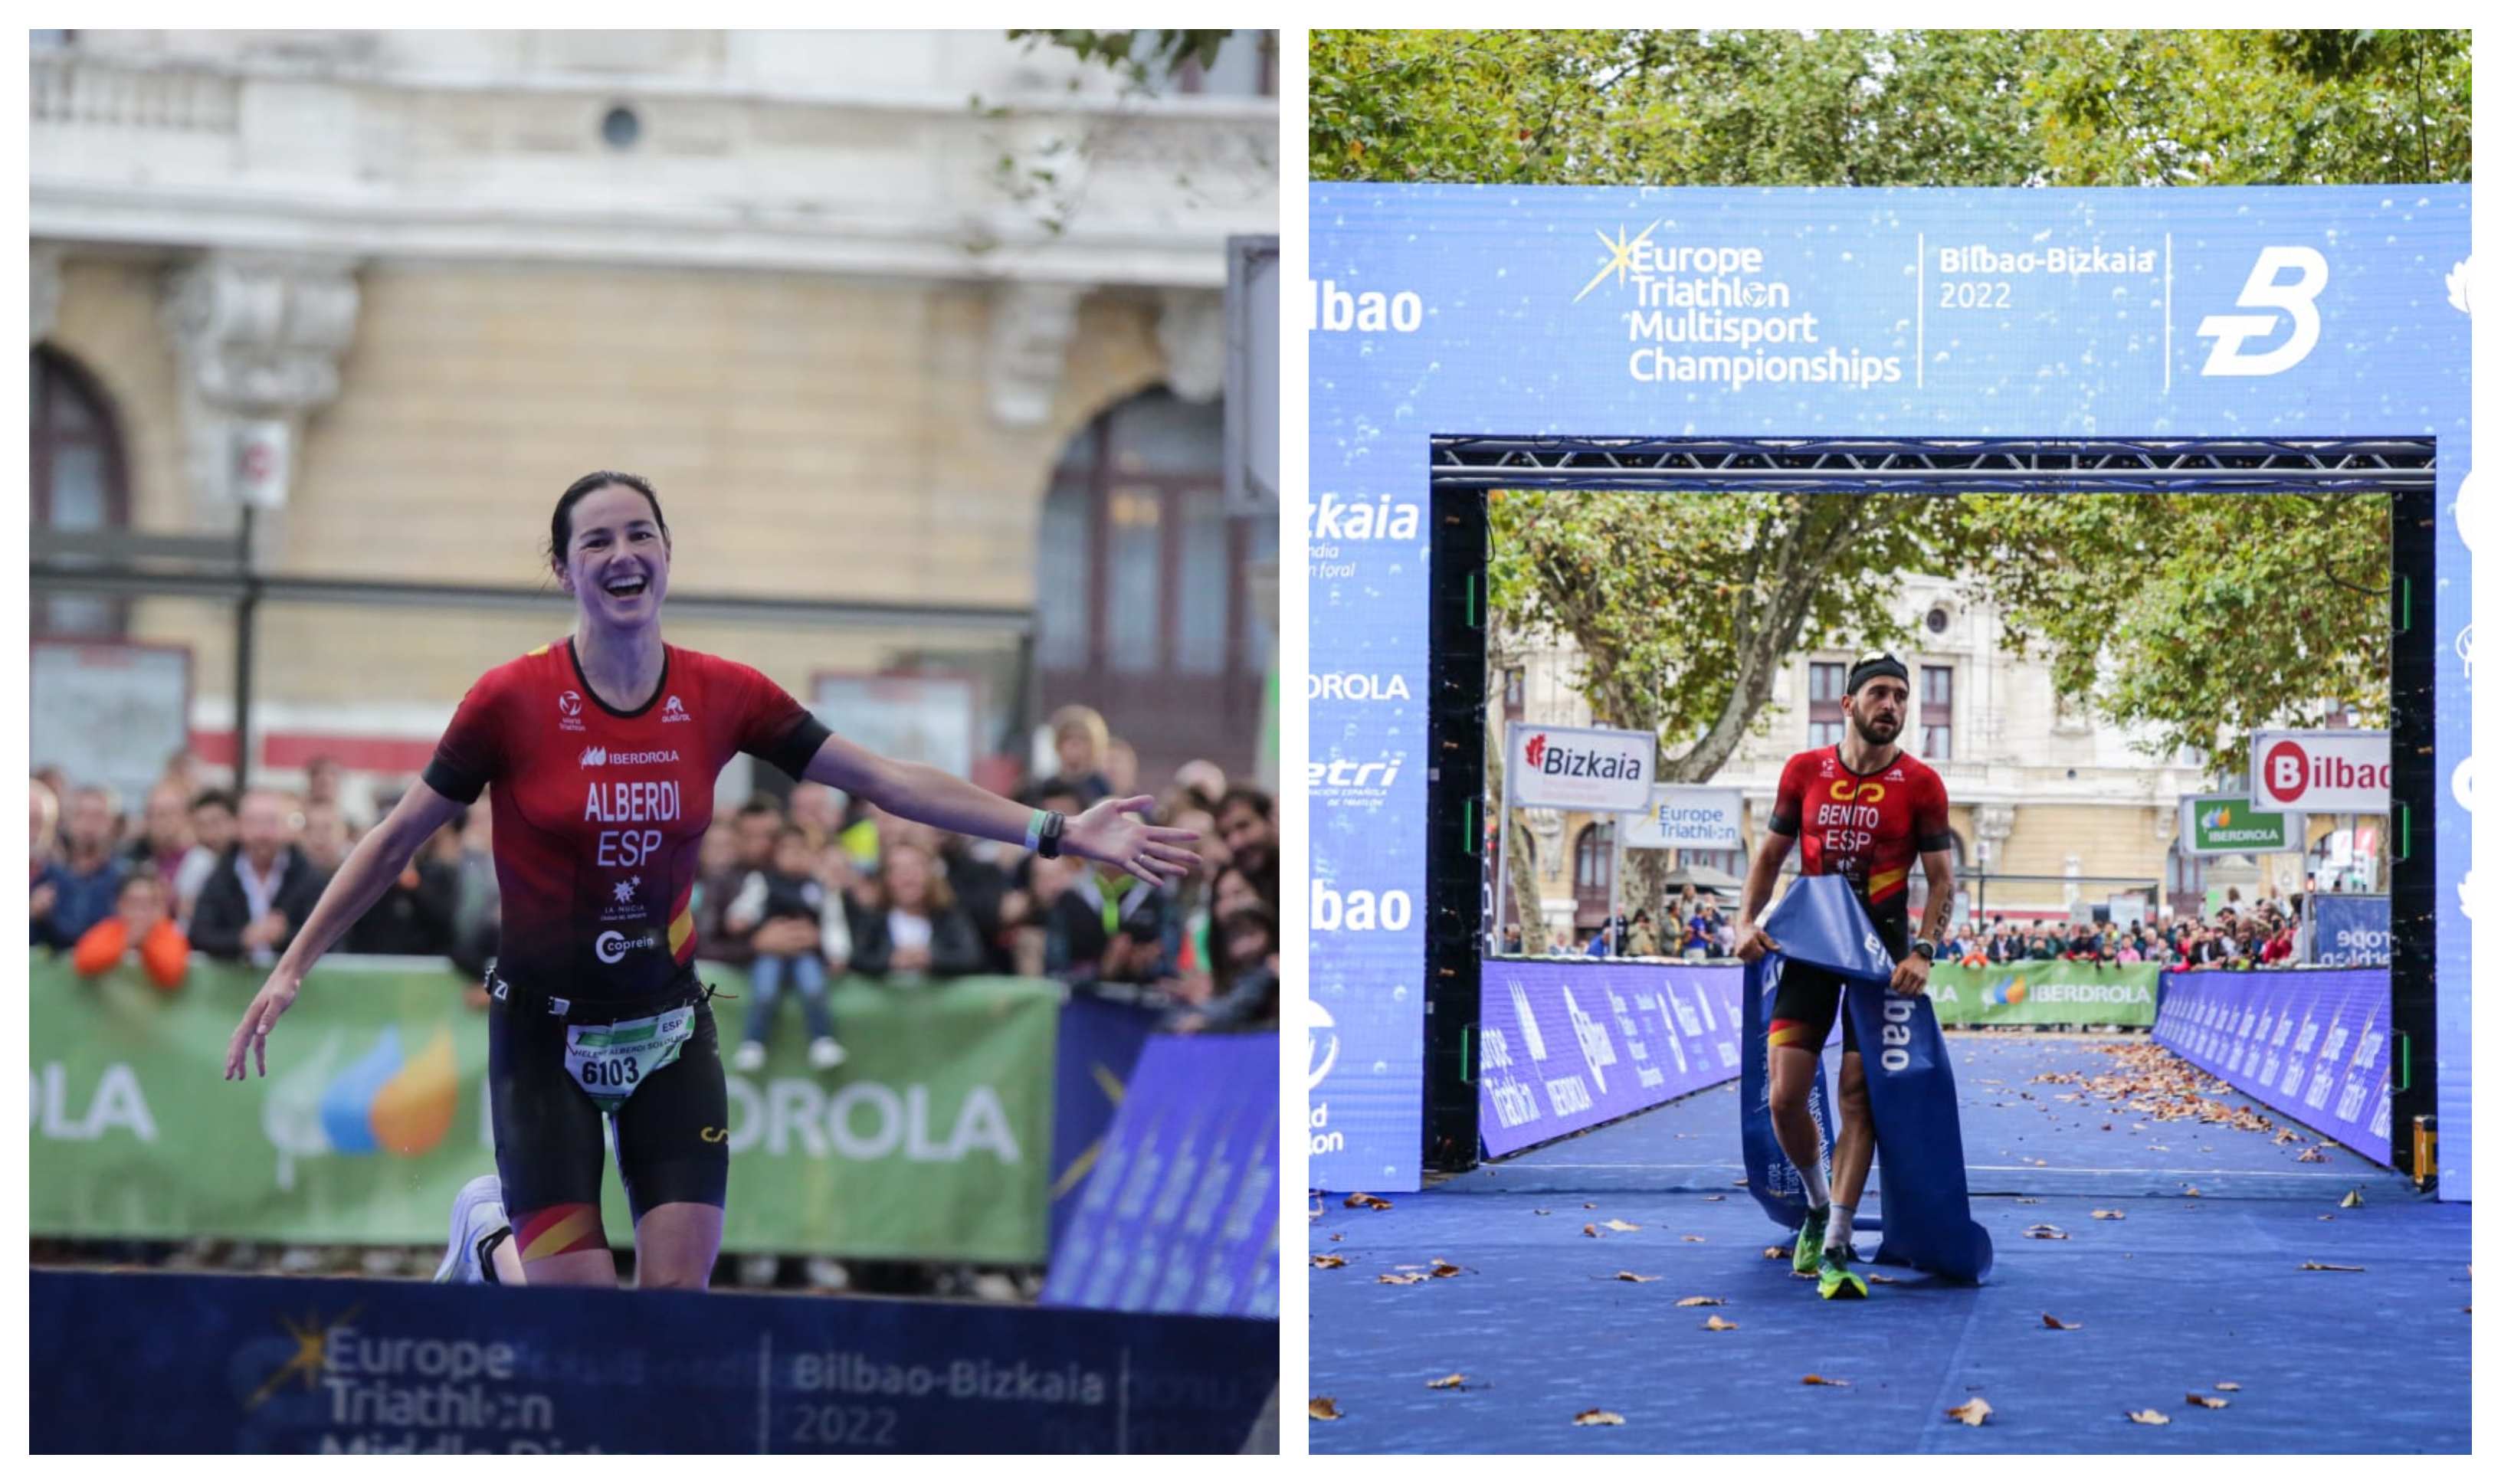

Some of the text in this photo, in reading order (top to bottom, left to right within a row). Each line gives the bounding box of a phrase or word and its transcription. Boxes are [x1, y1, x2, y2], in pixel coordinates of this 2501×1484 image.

[1631, 240, 1763, 277] Europe
[1939, 245, 2154, 274] Bilbao-Bizkaia
[1630, 275, 1790, 308] Triathlon
[1939, 283, 2012, 309] 2022
[1629, 308, 1819, 349] Multisport
[1629, 346, 1902, 391] Championships
[609, 750, 680, 765] IBERDROLA
[1544, 747, 1641, 781] Bizkaia
[585, 780, 680, 822] ALBERDI
[1660, 804, 1724, 823] Europe
[1818, 804, 1879, 829] BENITO
[598, 830, 663, 866] ESP
[1825, 829, 1872, 852] ESP
[2208, 828, 2280, 843] IBERDROLA
[1311, 879, 1411, 932] bao
[2030, 984, 2152, 1004] IBERDROLA
[662, 1018, 683, 1033] ESP
[582, 1056, 641, 1086] 6103
[29, 1062, 159, 1142] LA
[325, 1326, 515, 1378] Europe
[792, 1351, 1106, 1404] Bilbao-Bizkaia
[324, 1377, 554, 1430] Triathlon
[792, 1403, 899, 1445] 2022
